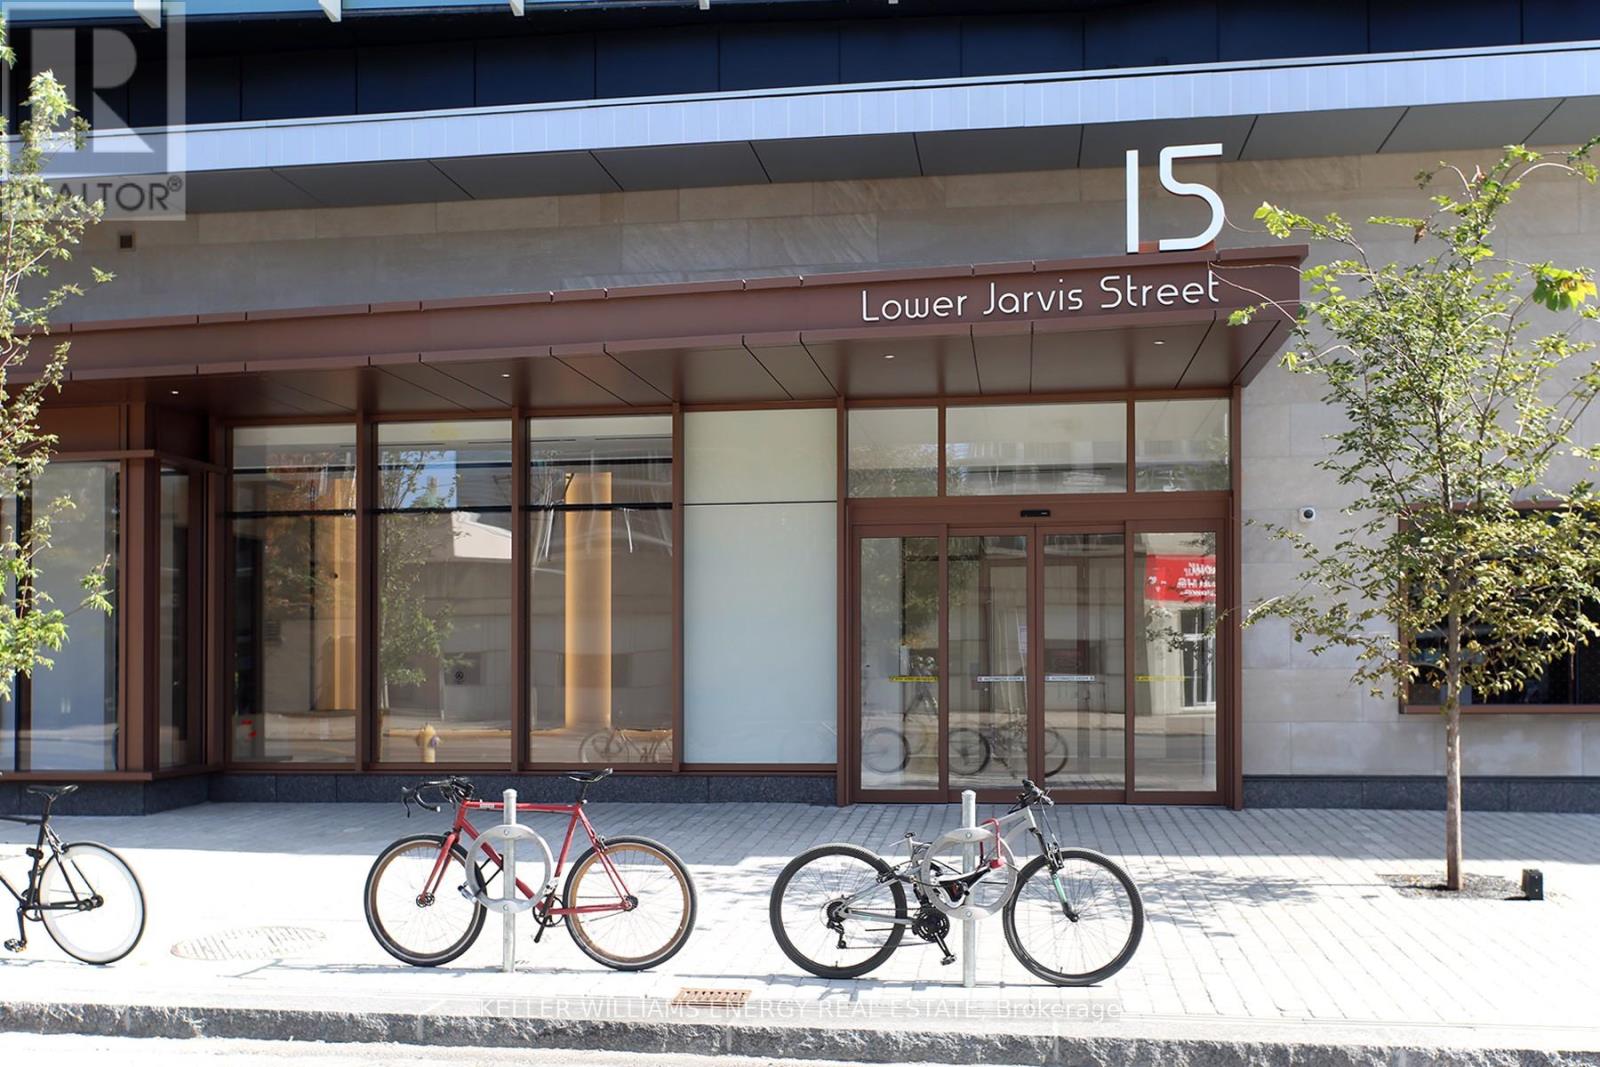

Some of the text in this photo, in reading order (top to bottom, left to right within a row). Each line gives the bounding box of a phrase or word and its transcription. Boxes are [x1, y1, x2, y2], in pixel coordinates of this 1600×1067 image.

[1126, 143, 1224, 253] 15
[862, 270, 1220, 322] Lower Jarvis Street
